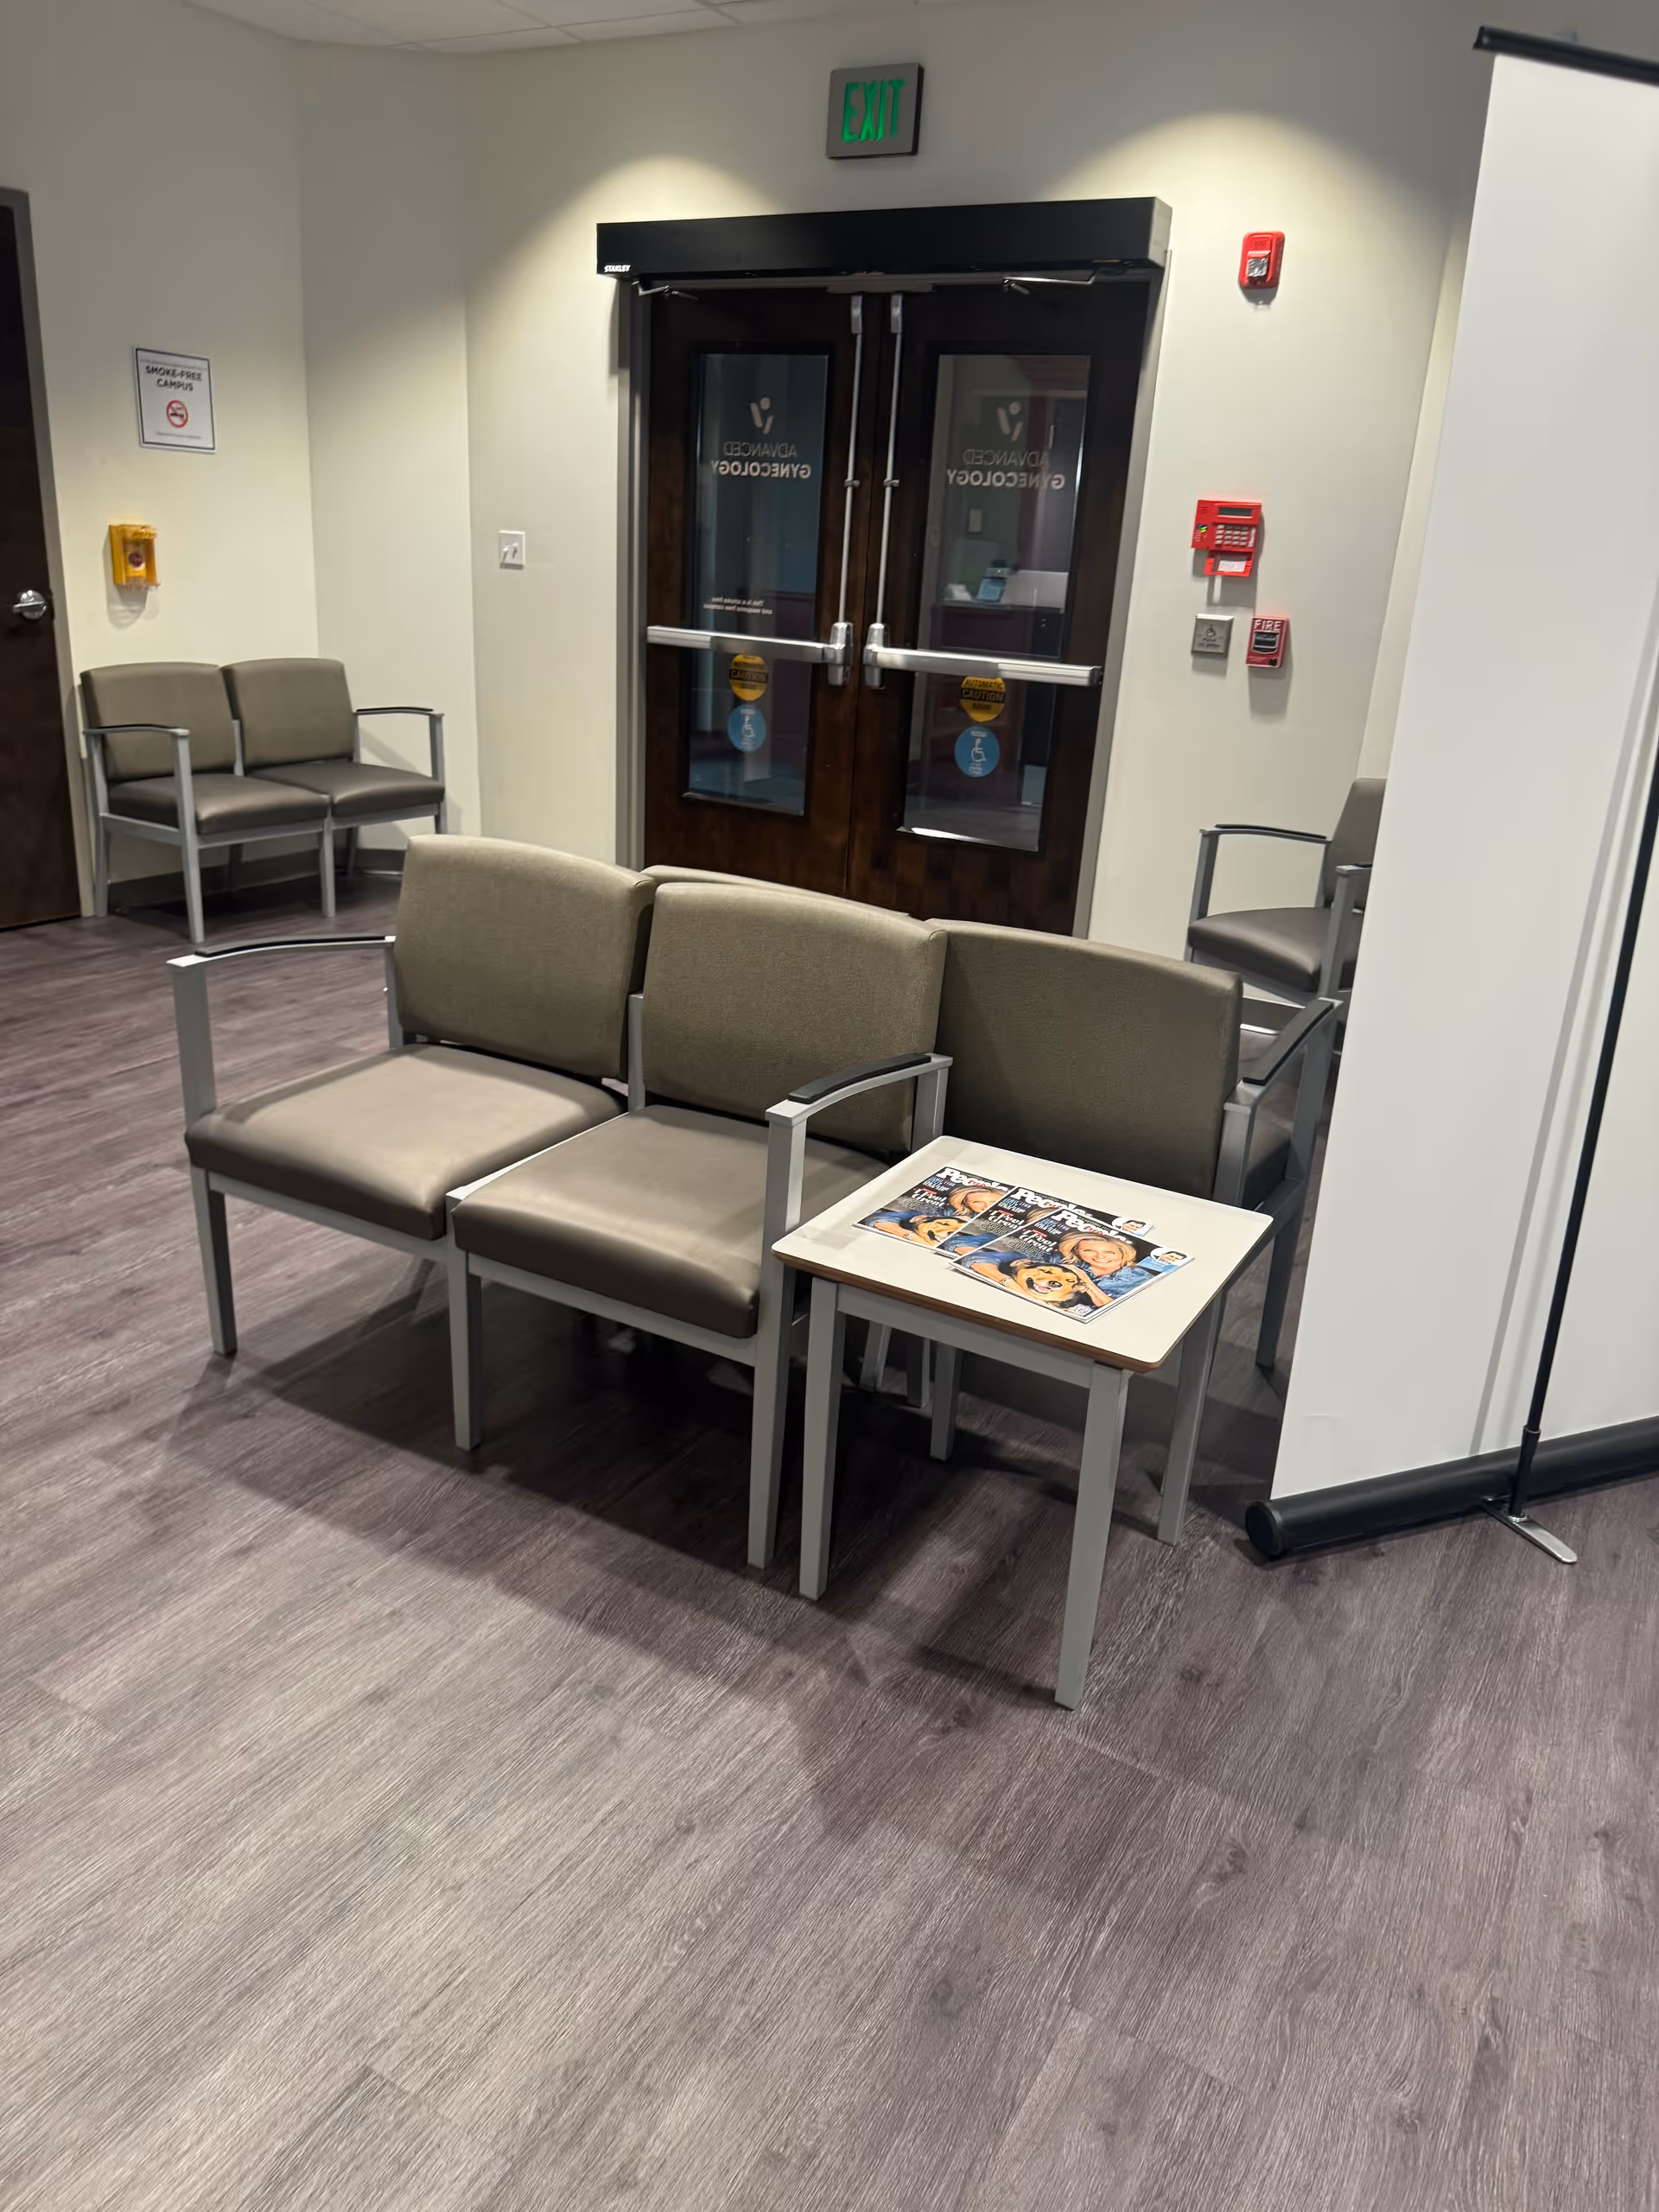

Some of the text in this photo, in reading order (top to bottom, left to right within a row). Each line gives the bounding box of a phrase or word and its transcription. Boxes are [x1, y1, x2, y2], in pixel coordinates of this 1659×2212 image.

[842, 78, 905, 142] EXIT
[145, 365, 203, 381] SMOKE-FREE
[156, 378, 194, 391] CAMPUS
[1254, 620, 1282, 631] FIRE
[962, 688, 1004, 703] CAUTION
